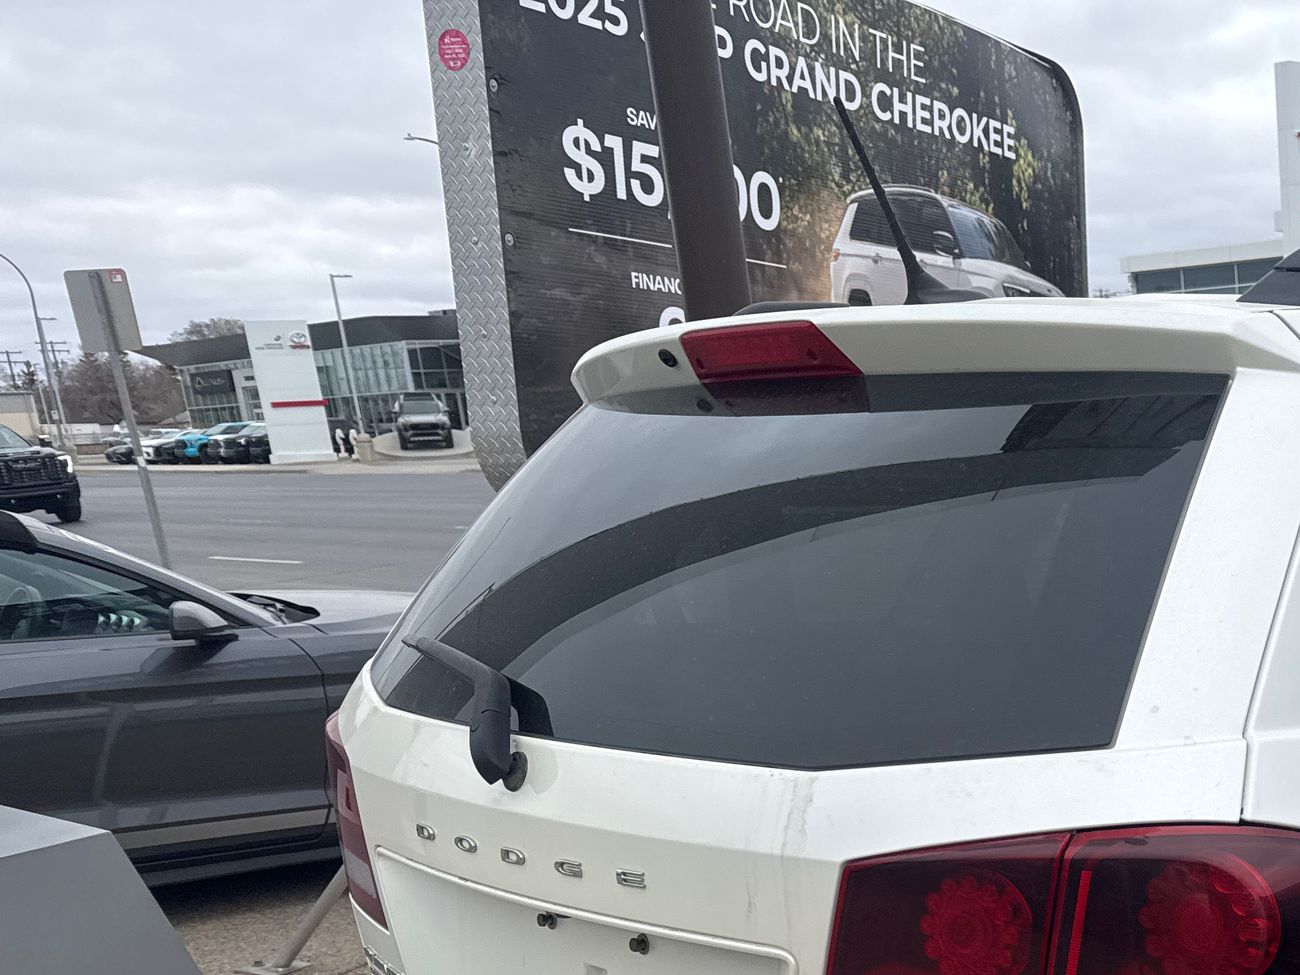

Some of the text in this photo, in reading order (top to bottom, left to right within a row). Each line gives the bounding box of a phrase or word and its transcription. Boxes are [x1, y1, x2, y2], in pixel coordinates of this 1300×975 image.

[519, 0, 629, 36] 25
[744, 38, 862, 111] GRAND
[871, 82, 1017, 160] CHEROKEE
[831, 14, 860, 62] IN
[869, 28, 926, 83] THE
[626, 107, 658, 130] SAV
[416, 822, 647, 889] DODGE
